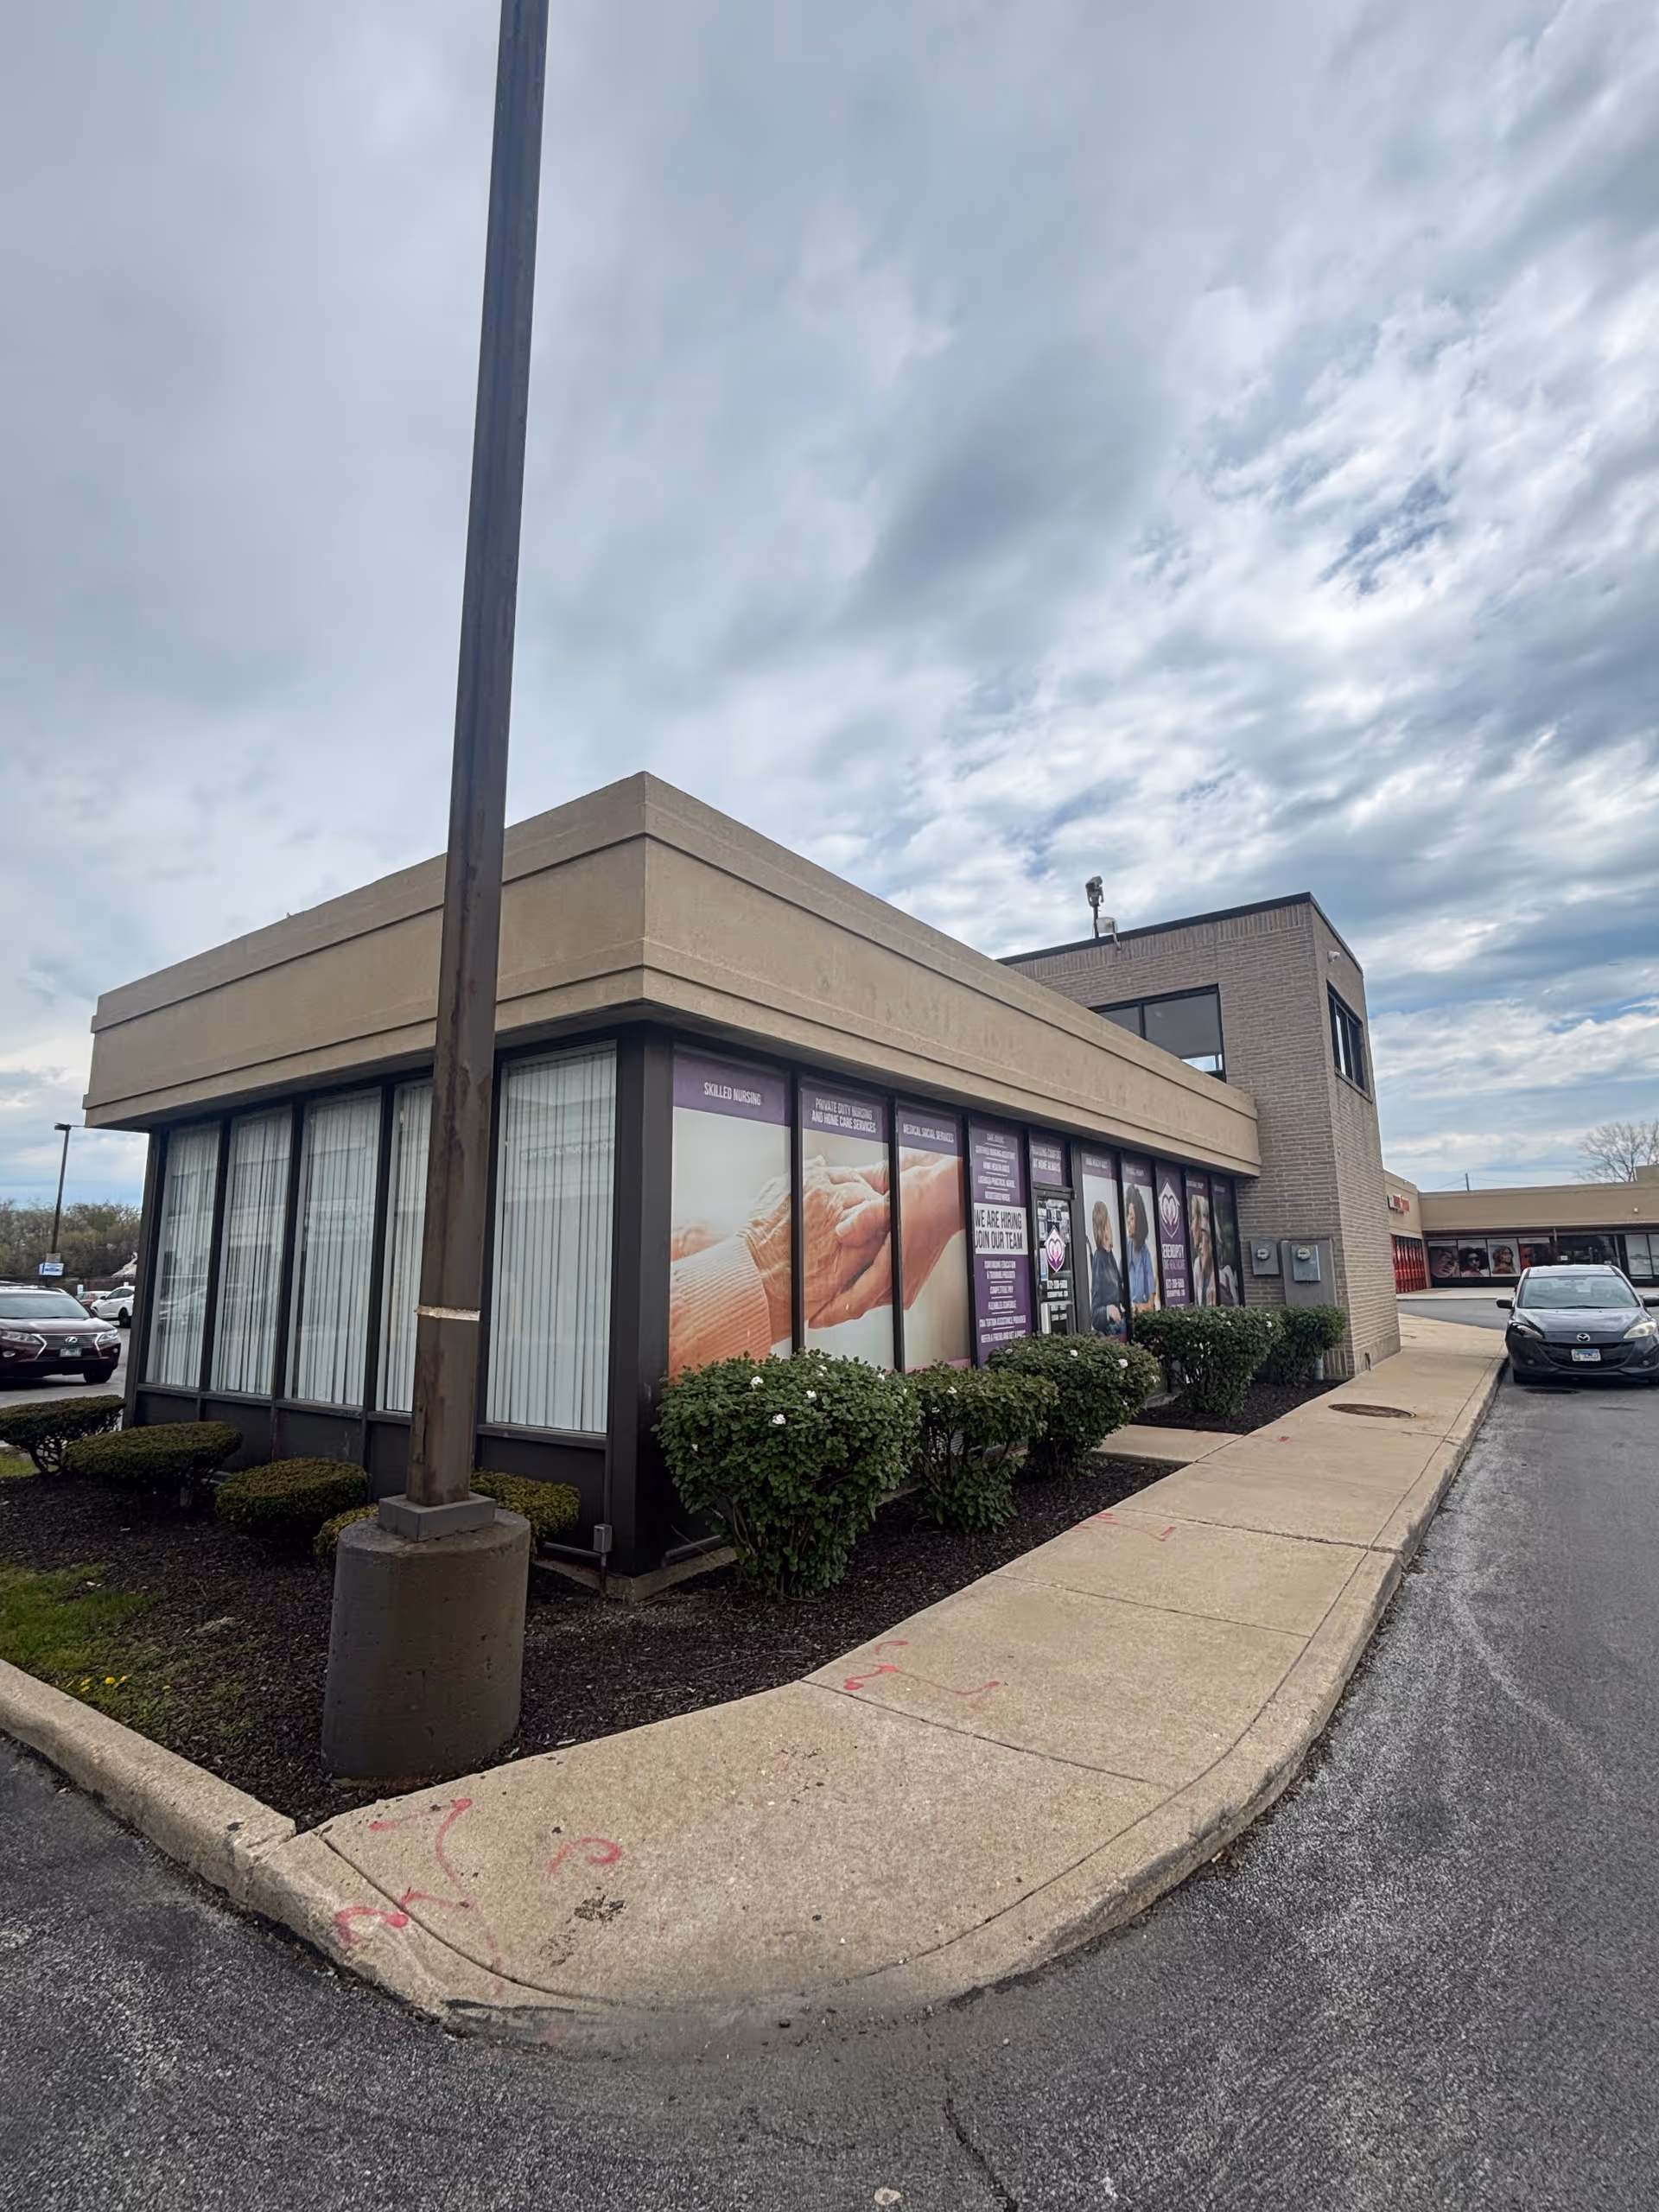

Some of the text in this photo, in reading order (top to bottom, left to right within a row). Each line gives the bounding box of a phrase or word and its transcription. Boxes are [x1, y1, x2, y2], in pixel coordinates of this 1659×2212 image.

[704, 1082, 761, 1106] SKILLED NURSING
[816, 1098, 873, 1121] PRIVATE DUTY NURSING
[812, 1110, 876, 1134] AND HOME CARE SERVICES
[903, 1123, 921, 1137] MEDICAL
[975, 1209, 1022, 1230] WE ARE HIRING
[975, 1229, 1023, 1249] JOIN OUR TEAM
